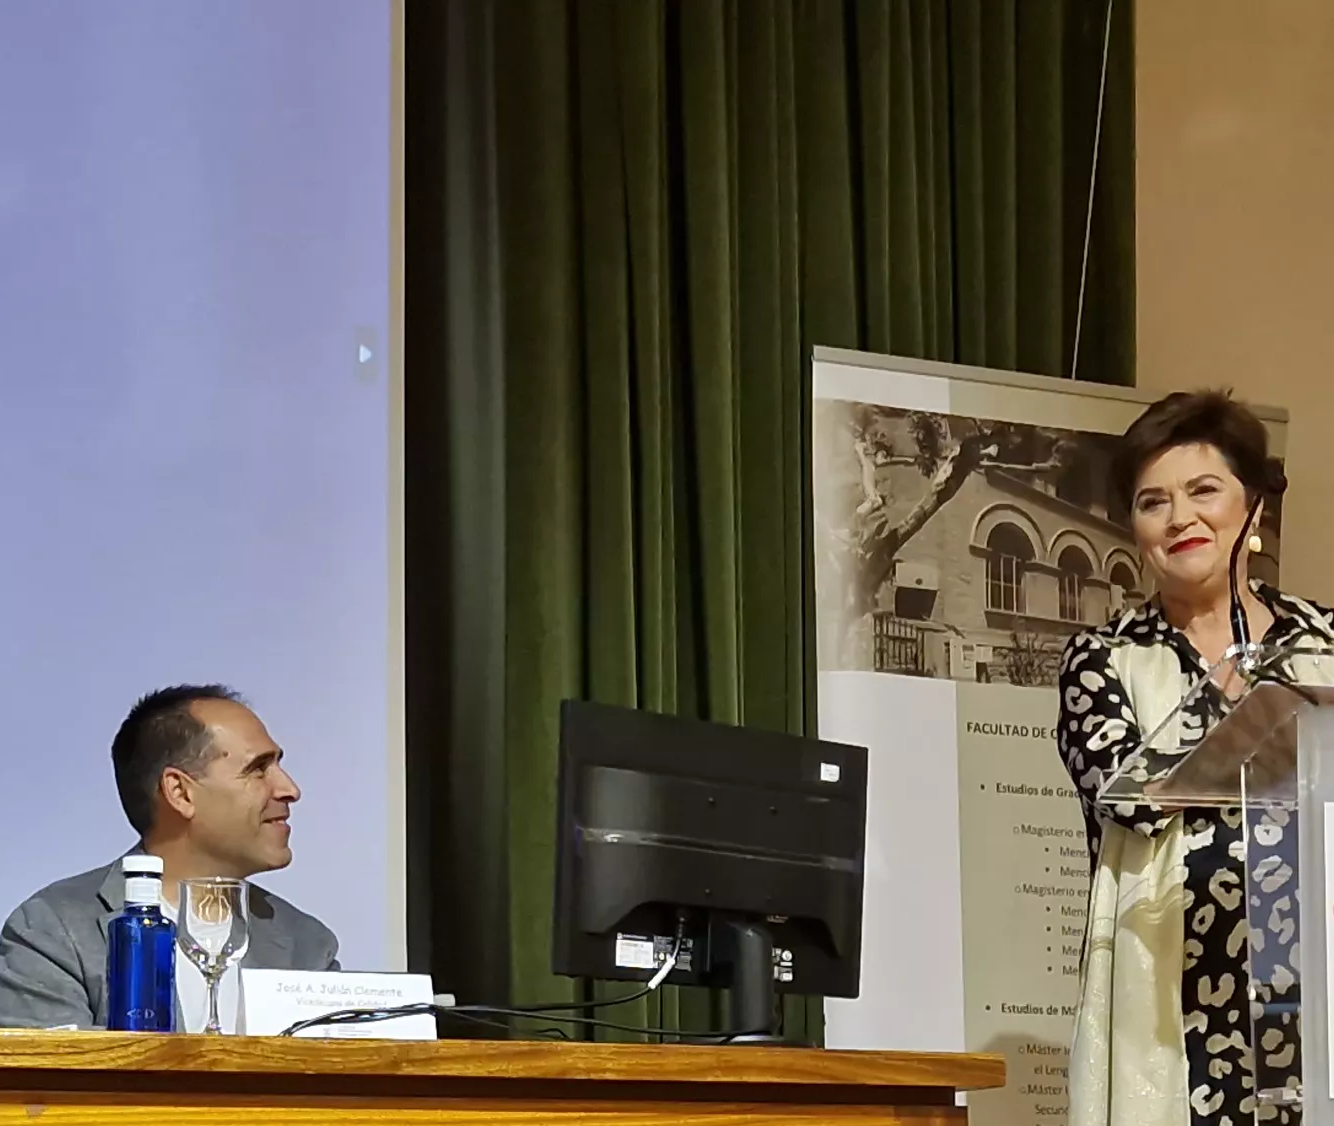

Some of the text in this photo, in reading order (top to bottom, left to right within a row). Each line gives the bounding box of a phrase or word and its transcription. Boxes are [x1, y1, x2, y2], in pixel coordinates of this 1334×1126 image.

[966, 721, 1029, 737] FACULTAD
[1032, 727, 1048, 739] DE
[996, 782, 1039, 796] Estudios
[1041, 786, 1054, 797] de
[1020, 823, 1074, 838] Magisterio
[1022, 882, 1075, 898] Magisterio
[275, 982, 303, 994] José
[354, 985, 403, 998] Clemente
[1000, 1002, 1044, 1015] Estudios
[1046, 1004, 1059, 1016] de
